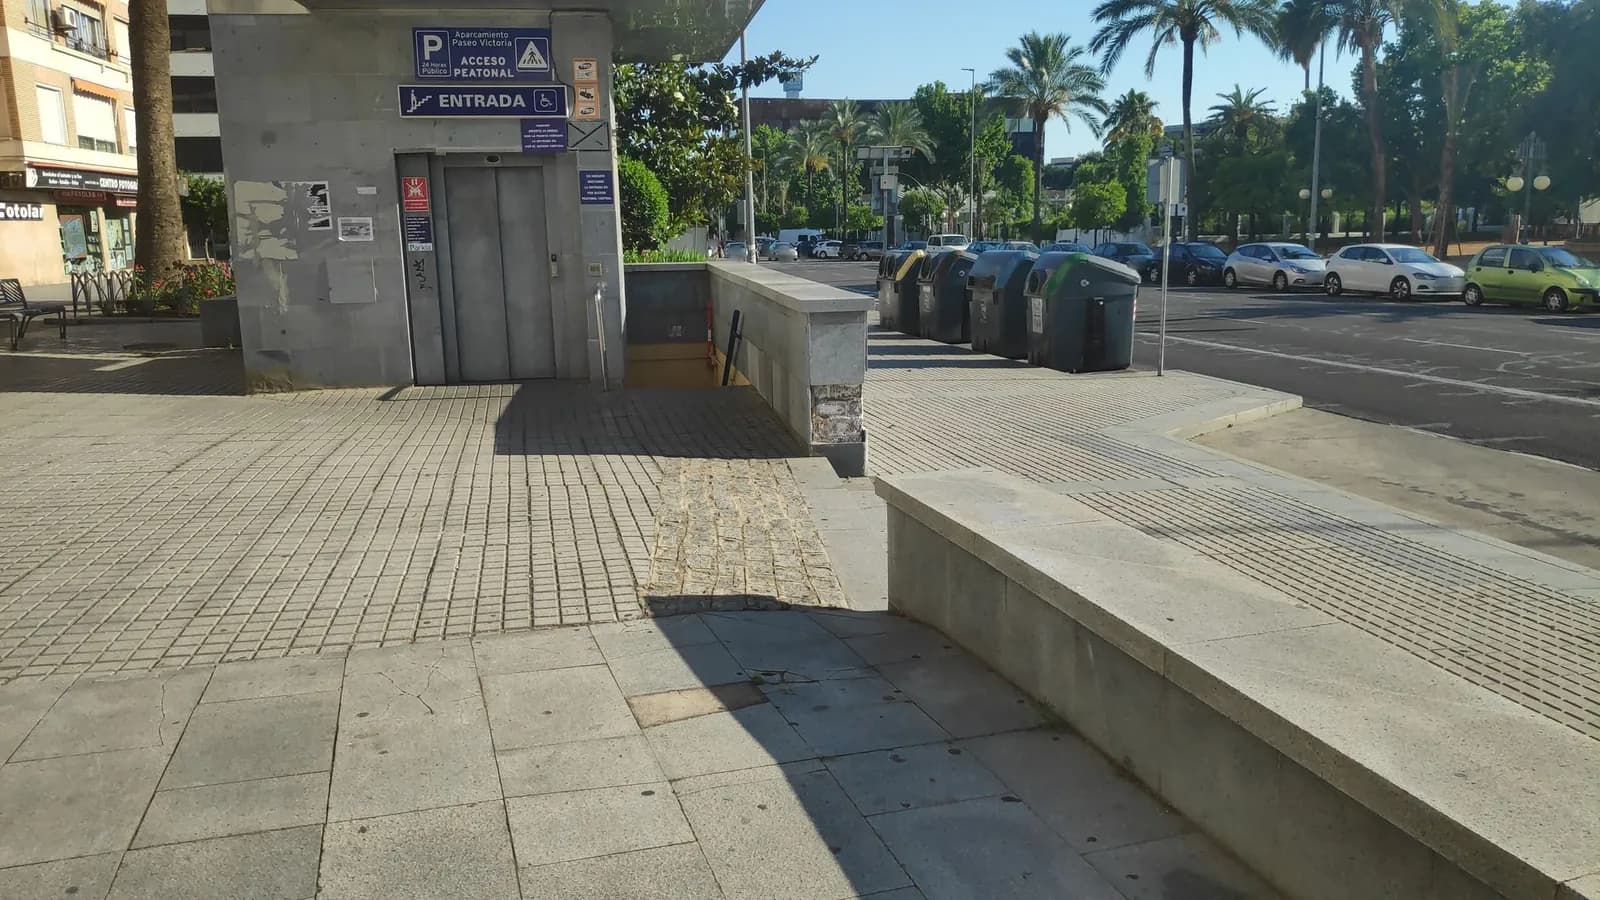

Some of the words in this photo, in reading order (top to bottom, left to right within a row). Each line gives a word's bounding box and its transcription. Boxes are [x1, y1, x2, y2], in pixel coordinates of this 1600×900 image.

[455, 31, 509, 39] Aparcamiento
[423, 35, 443, 60] P
[452, 39, 477, 47] Paseo
[479, 39, 512, 47] Victoria
[460, 56, 506, 66] ACCESO
[422, 67, 448, 75] Público
[454, 68, 515, 78] PEATONAL
[439, 94, 526, 108] ENTRADA
